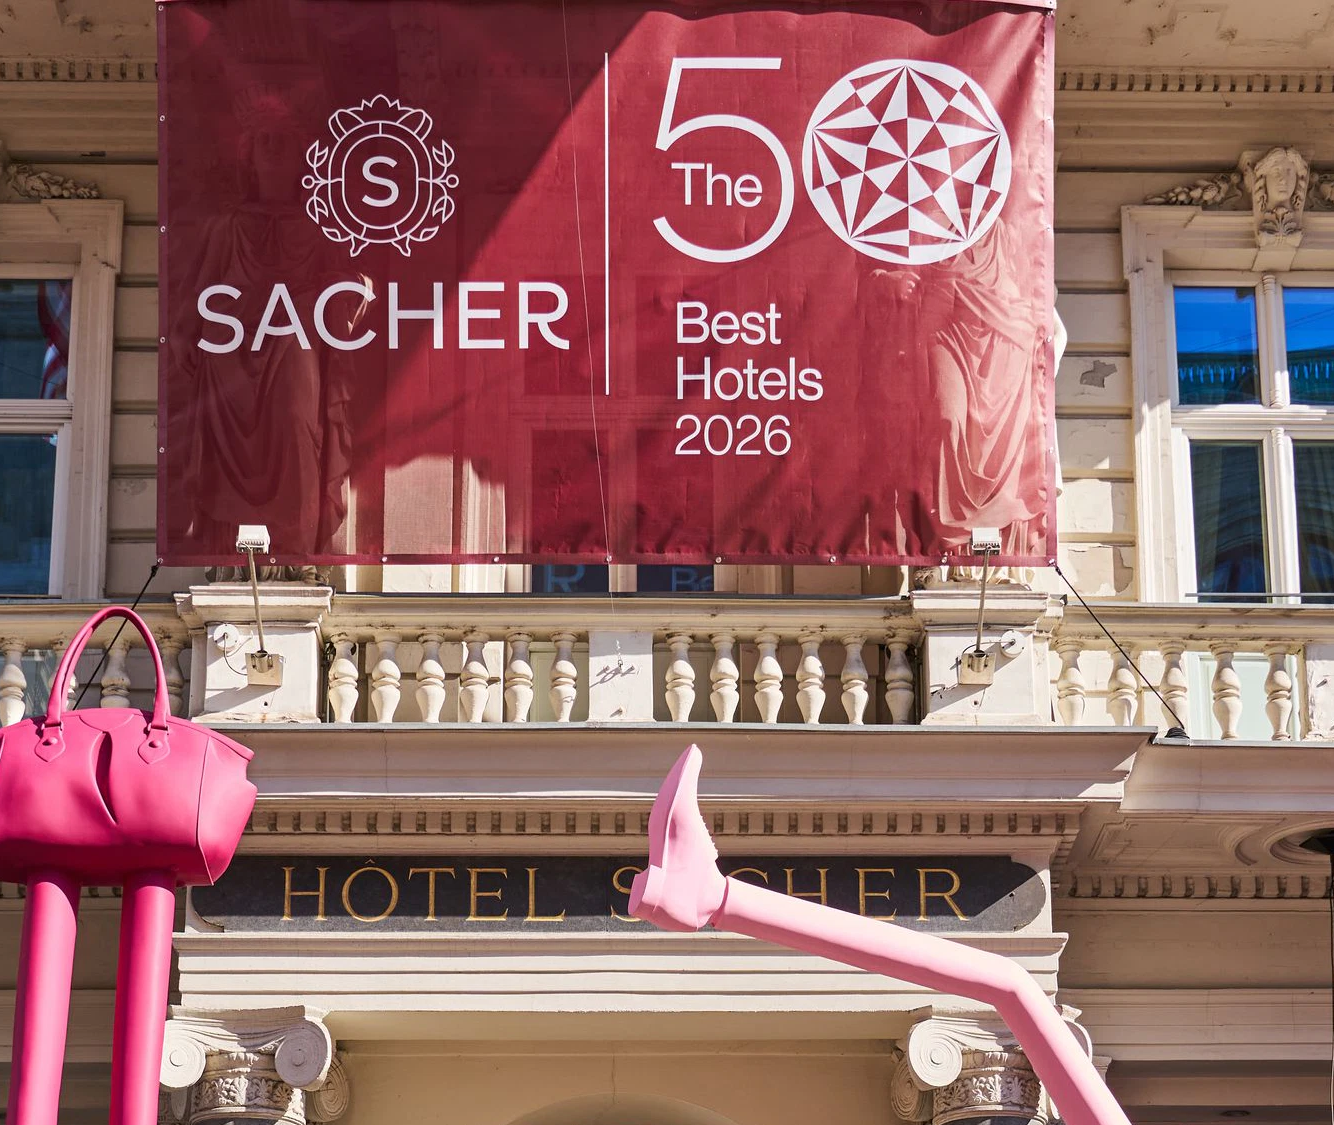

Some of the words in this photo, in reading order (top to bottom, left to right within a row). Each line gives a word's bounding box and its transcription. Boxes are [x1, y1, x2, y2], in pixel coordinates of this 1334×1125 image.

[361, 156, 399, 207] S
[671, 162, 763, 208] The
[197, 281, 570, 354] SACHER
[676, 301, 782, 346] Best
[677, 357, 824, 402] Hotels
[675, 415, 792, 456] 2026
[283, 859, 565, 923] HÔTEL
[611, 867, 970, 922] SHER
